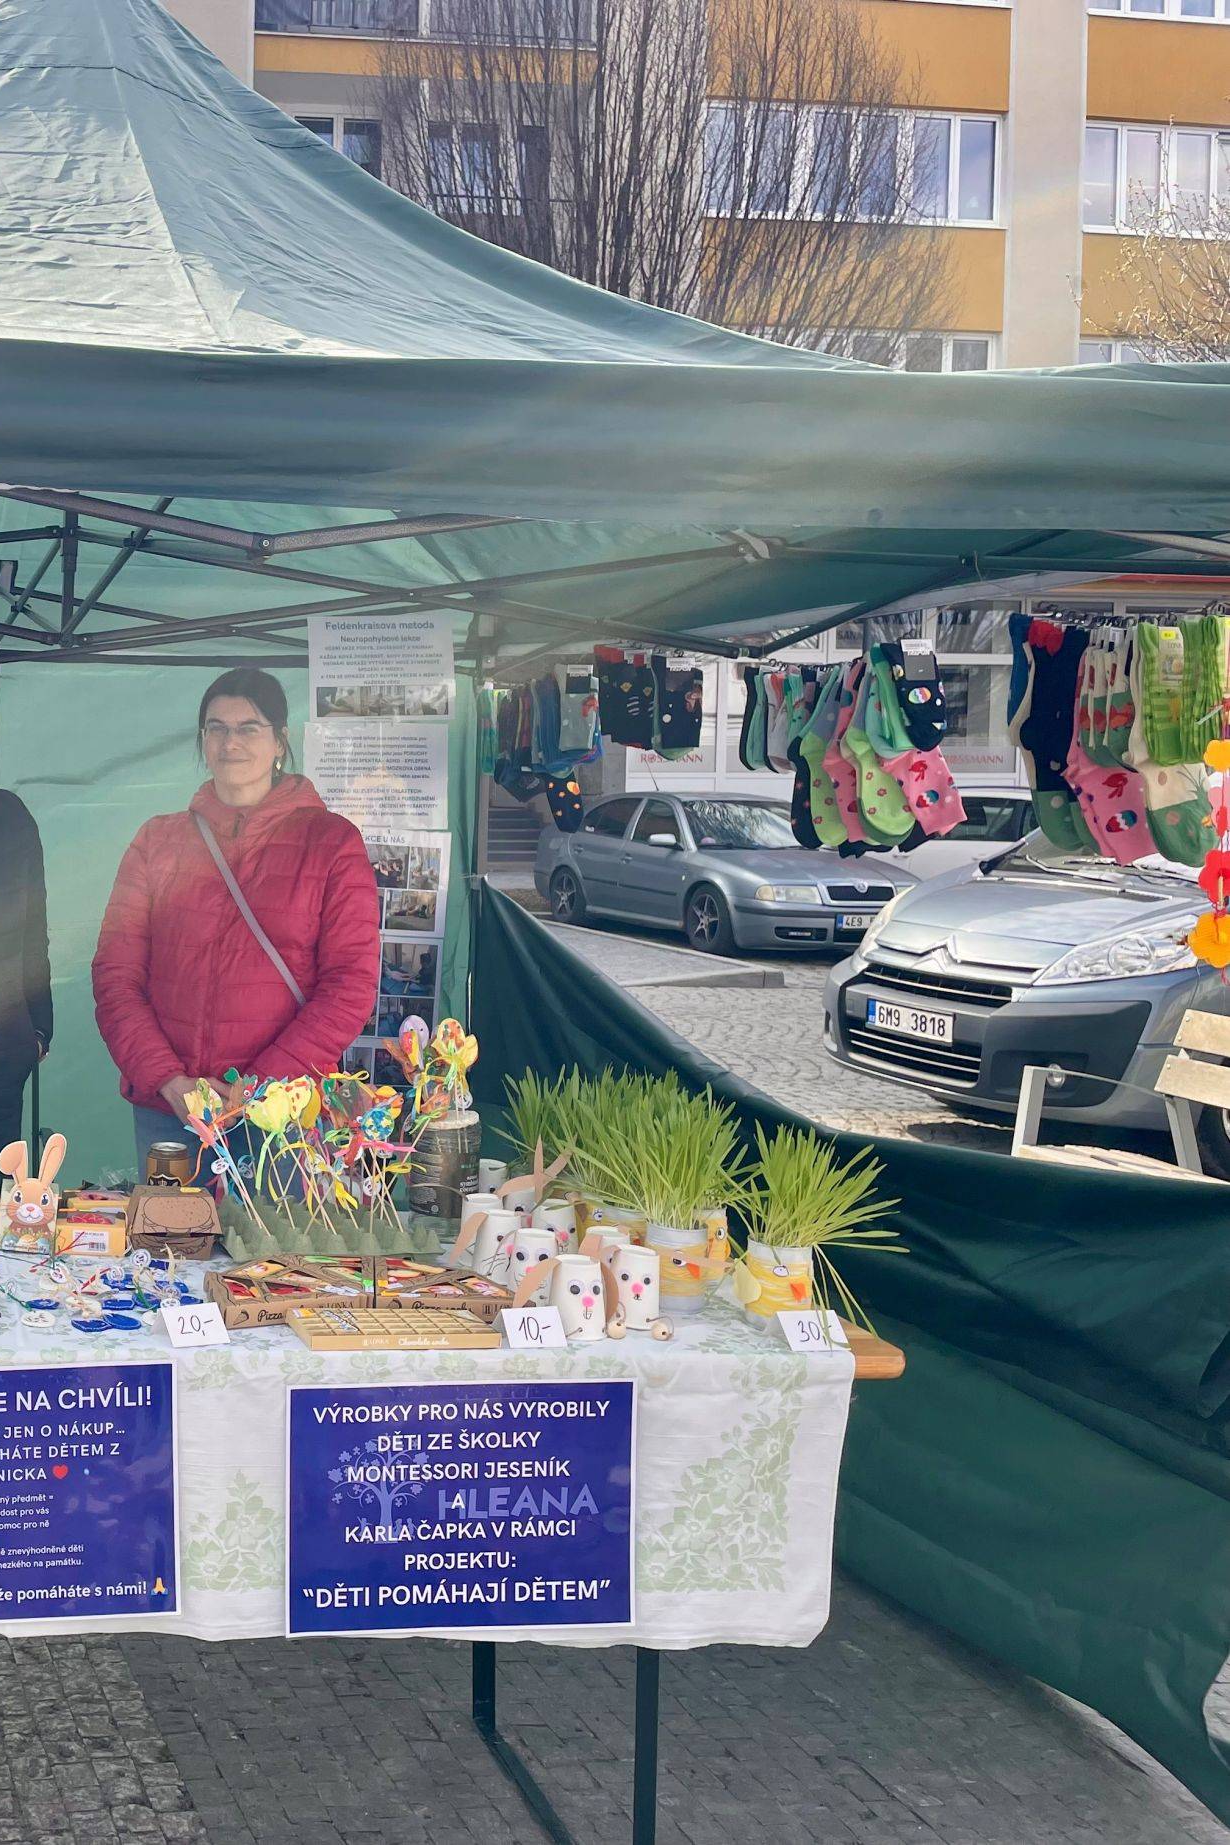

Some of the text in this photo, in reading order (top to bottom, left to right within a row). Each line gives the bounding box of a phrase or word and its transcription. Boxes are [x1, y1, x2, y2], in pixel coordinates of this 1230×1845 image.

[325, 620, 434, 630] Feldenkraisova metoda
[390, 835, 405, 844] NÁS
[845, 916, 863, 927] 4E9
[878, 1005, 946, 1037] 6M9 3818
[258, 1309, 284, 1322] Pizza
[16, 1390, 51, 1411] NA
[58, 1382, 151, 1409] CHVÍLI!
[312, 1398, 609, 1423] VÝROBKY PRO NÁS VYROBILY
[3, 1425, 34, 1439] JEN
[40, 1425, 52, 1437] O
[377, 1428, 541, 1452] DĚTI ZE ŠKOLKY
[48, 1442, 103, 1458] DĚTEM
[110, 1442, 120, 1455] Z
[347, 1456, 569, 1482] MONTESSORI JESENÍK
[11, 1493, 46, 1504] předmět
[438, 1483, 598, 1520] HLEANA
[451, 1493, 465, 1509] A
[20, 1507, 34, 1517] pro
[36, 1506, 49, 1515] vás
[23, 1521, 38, 1530] pro
[39, 1519, 50, 1527] ně
[345, 1516, 575, 1542] KARLA ČAPKA V RÁMCI
[7, 1544, 66, 1556] znevýhodněné
[67, 1544, 84, 1552] děti
[45, 1557, 84, 1568] památku.
[404, 1551, 516, 1570] PROJEKTU:
[17, 1584, 91, 1603] pomáháte
[94, 1586, 102, 1596] s
[106, 1580, 146, 1596] námi!
[378, 1577, 507, 1605] POMÁHAJÍ
